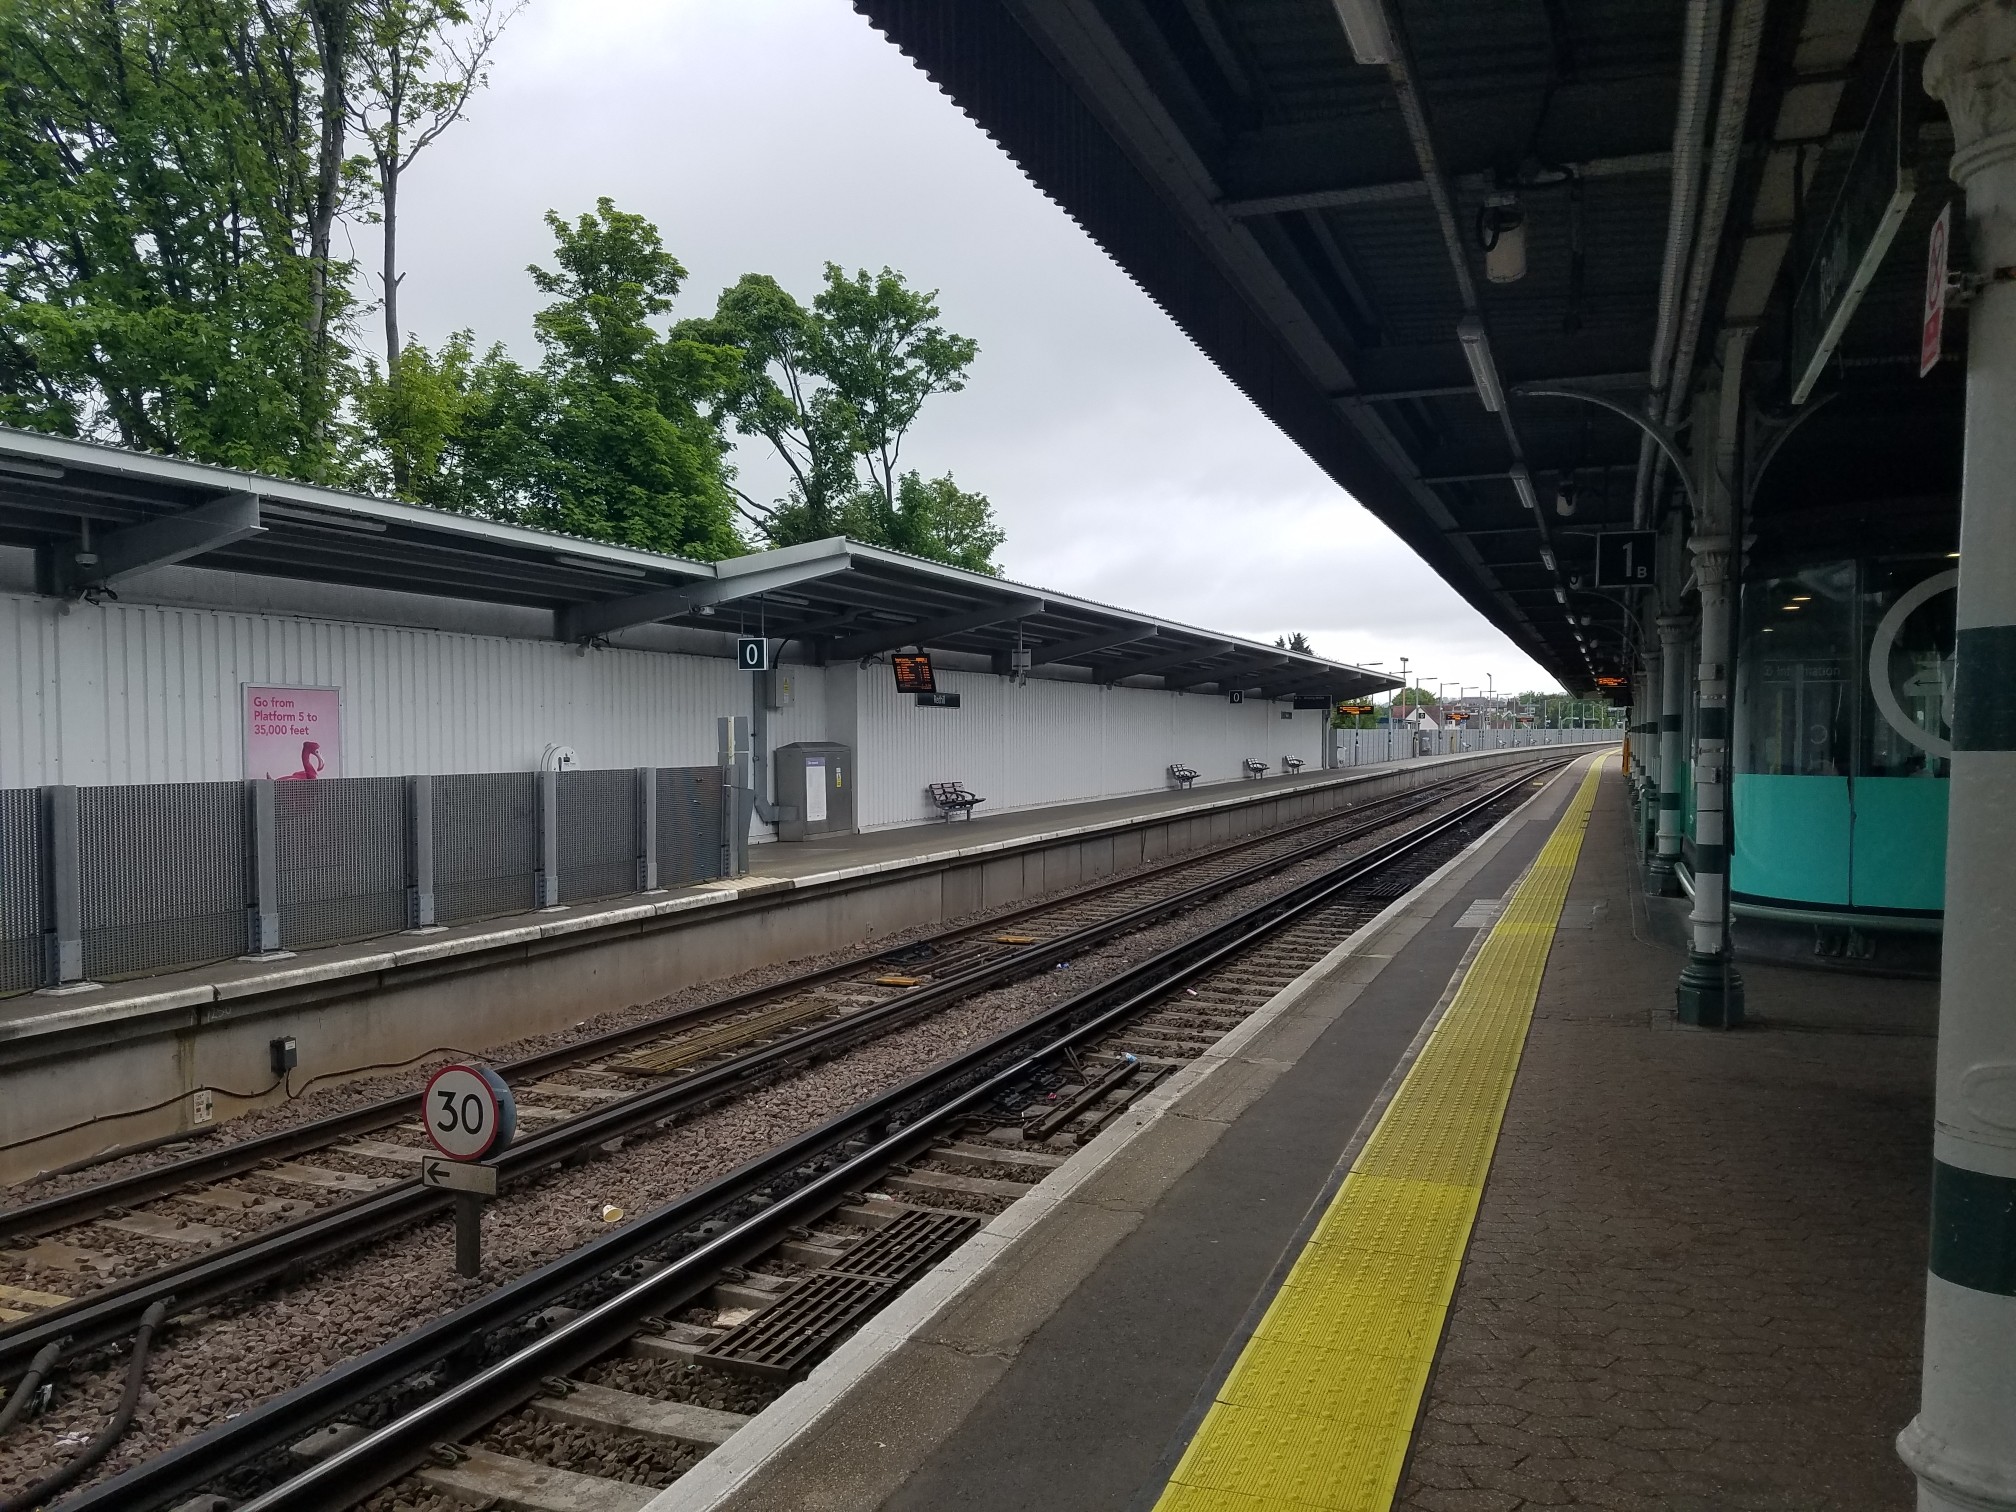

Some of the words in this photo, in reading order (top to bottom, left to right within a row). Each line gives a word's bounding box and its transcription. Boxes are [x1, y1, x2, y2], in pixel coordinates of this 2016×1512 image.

[746, 643, 758, 665] 0
[253, 696, 269, 708] Go
[271, 697, 295, 709] from
[254, 710, 296, 722] Platform
[298, 711, 305, 722] 5
[306, 712, 318, 722] to
[254, 724, 287, 737] 35,000
[290, 725, 310, 736] feet
[436, 1090, 484, 1135] 30
